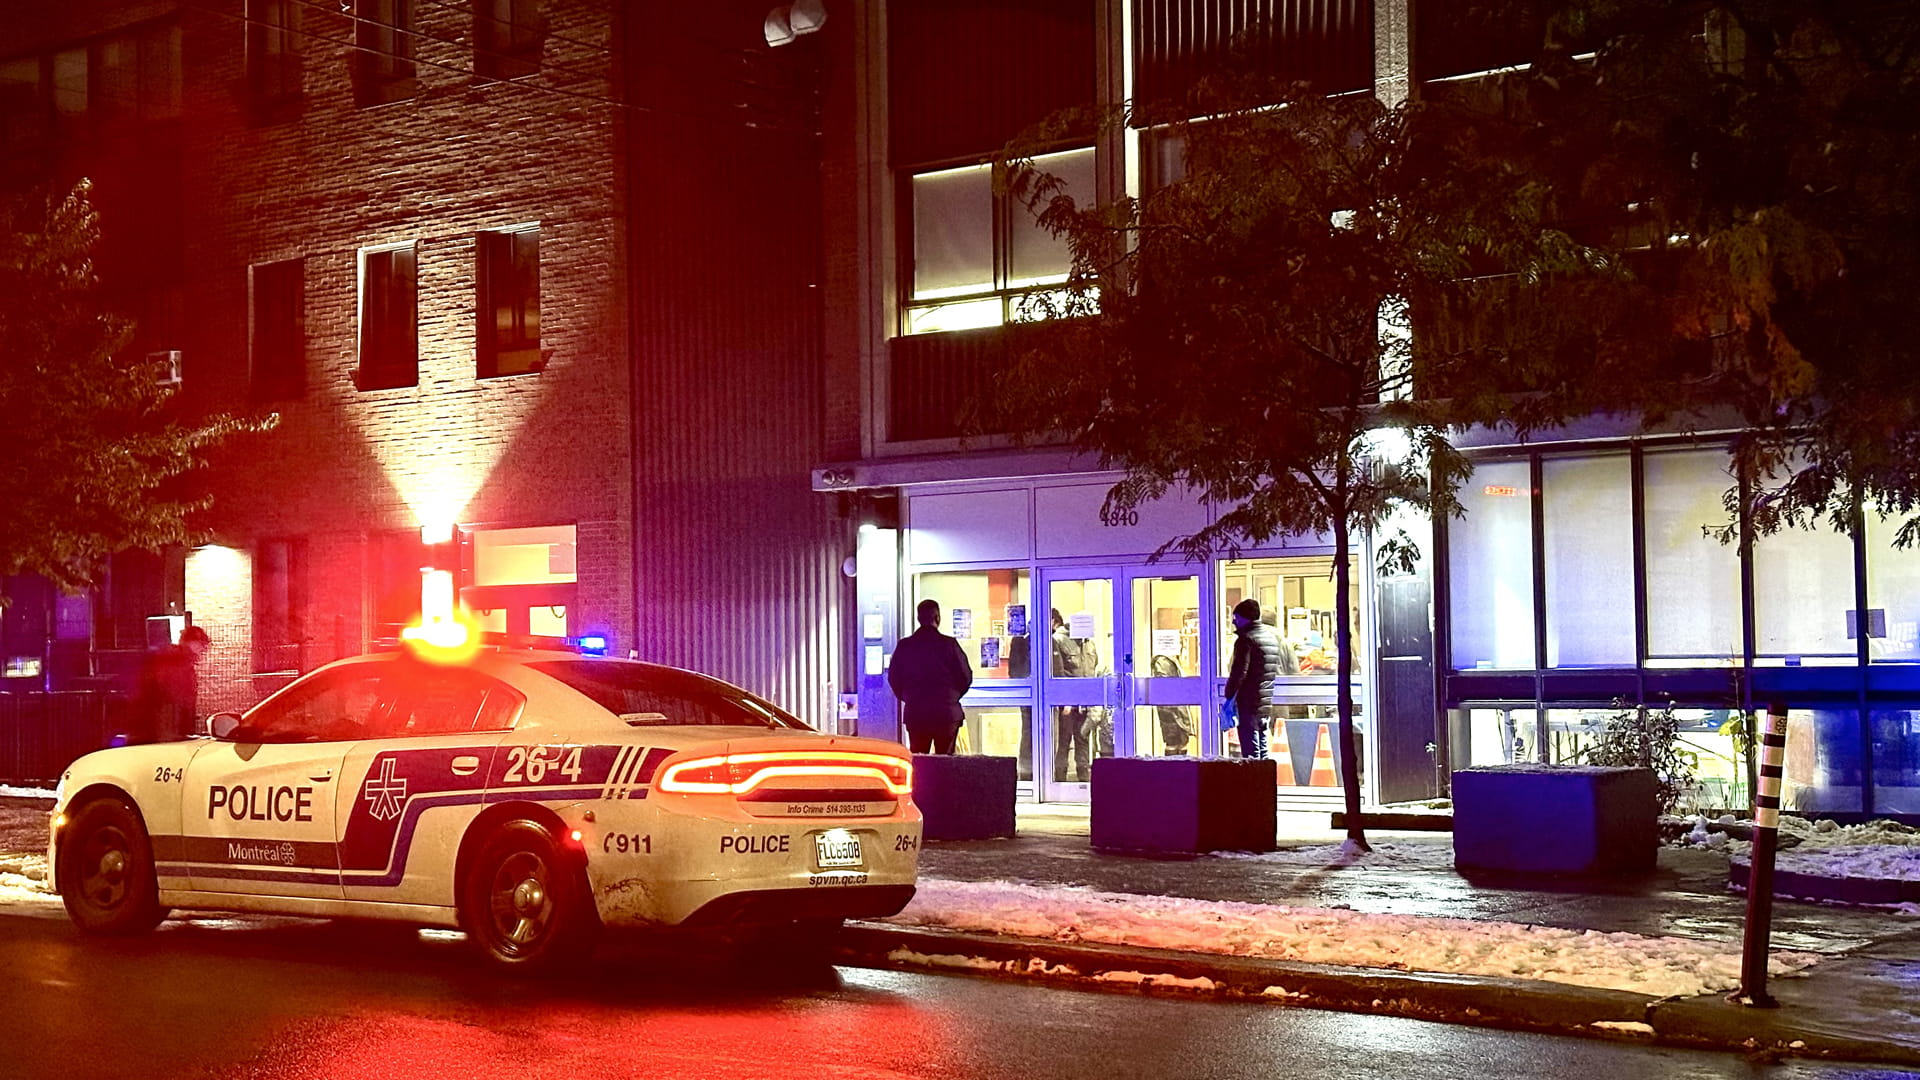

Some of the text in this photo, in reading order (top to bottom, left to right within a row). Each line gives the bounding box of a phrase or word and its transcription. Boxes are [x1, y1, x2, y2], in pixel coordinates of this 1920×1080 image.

[1101, 511, 1138, 527] 4840
[154, 766, 183, 783] 26-4
[503, 747, 582, 783] 26-4
[208, 785, 313, 822] POLICE
[787, 804, 801, 814] Info
[802, 804, 824, 814] Crime
[826, 804, 838, 814] 514
[228, 842, 281, 862] Montréal
[616, 834, 651, 854] 911
[720, 835, 790, 854] POLICE
[817, 841, 860, 860] FLC6508
[895, 834, 917, 852] 26-4
[809, 874, 868, 887] spvm.qc.ca
